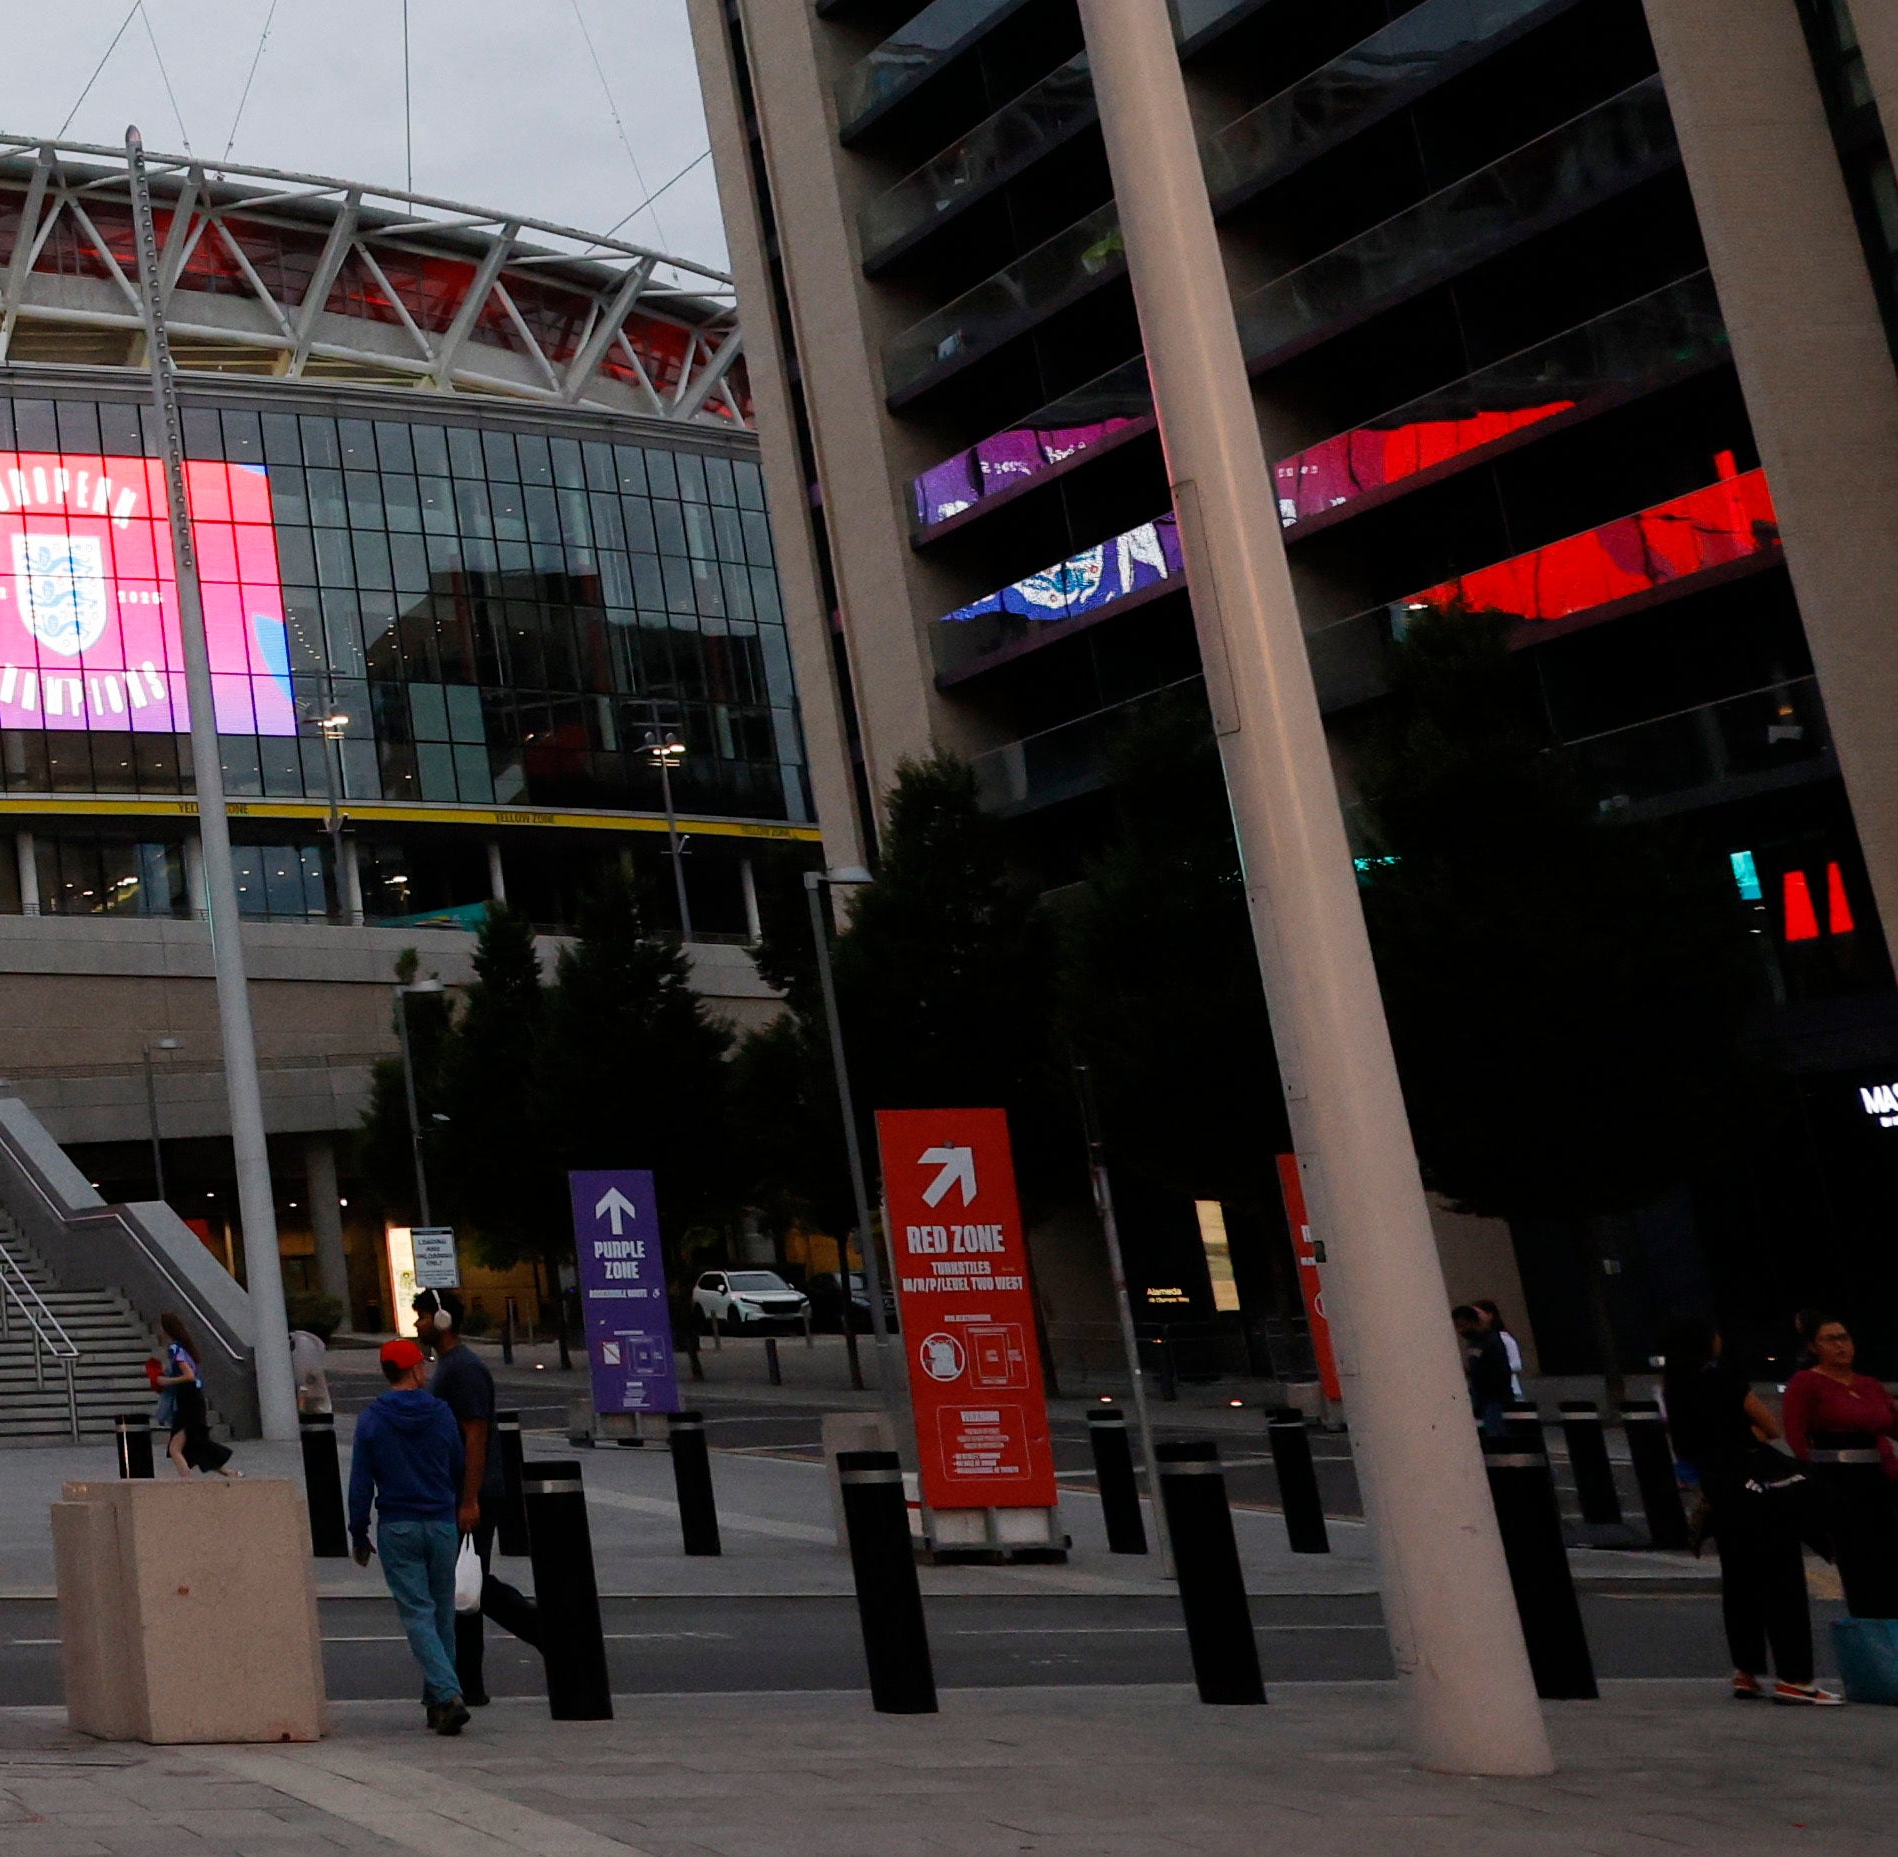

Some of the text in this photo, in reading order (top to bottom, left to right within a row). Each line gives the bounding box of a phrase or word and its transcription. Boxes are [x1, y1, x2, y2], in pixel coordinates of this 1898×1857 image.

[178, 801, 249, 814] YELL ONE
[906, 1224, 1006, 1254] RED ZONE
[593, 1240, 646, 1260] PURPLE
[604, 1261, 640, 1280] ZONE
